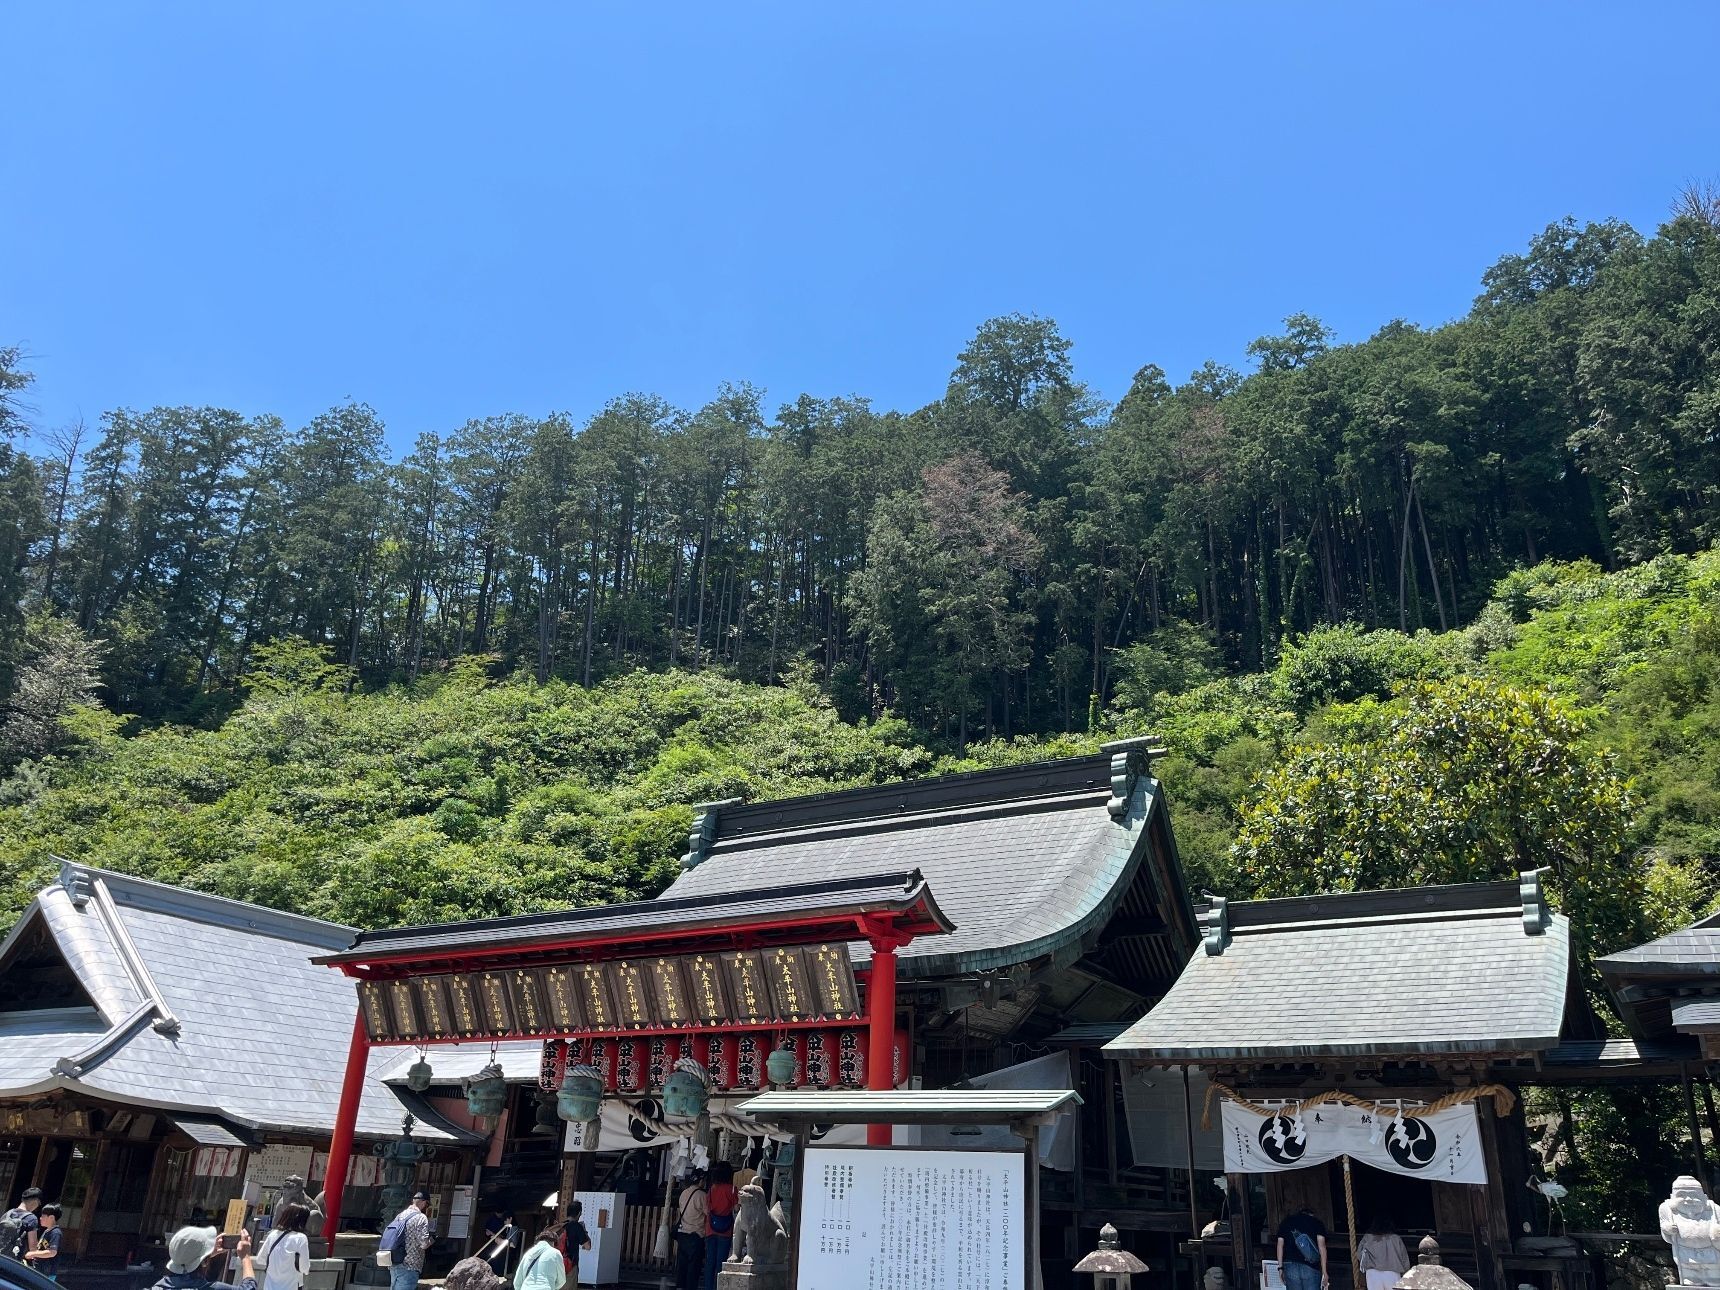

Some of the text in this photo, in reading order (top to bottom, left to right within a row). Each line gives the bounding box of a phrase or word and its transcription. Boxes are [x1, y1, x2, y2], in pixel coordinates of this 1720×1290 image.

[524, 985, 537, 1026] 太平山神社
[556, 982, 570, 1024] 太平山神社
[590, 979, 605, 1023] 太平山神社
[626, 977, 640, 1020] 太平山神社
[663, 974, 679, 1019] 太平山神社
[702, 971, 717, 1017] 太平山神社
[742, 968, 758, 1014] 太平山神社
[783, 965, 799, 1012] 太平山神社
[826, 962, 843, 1010] 太平山神社
